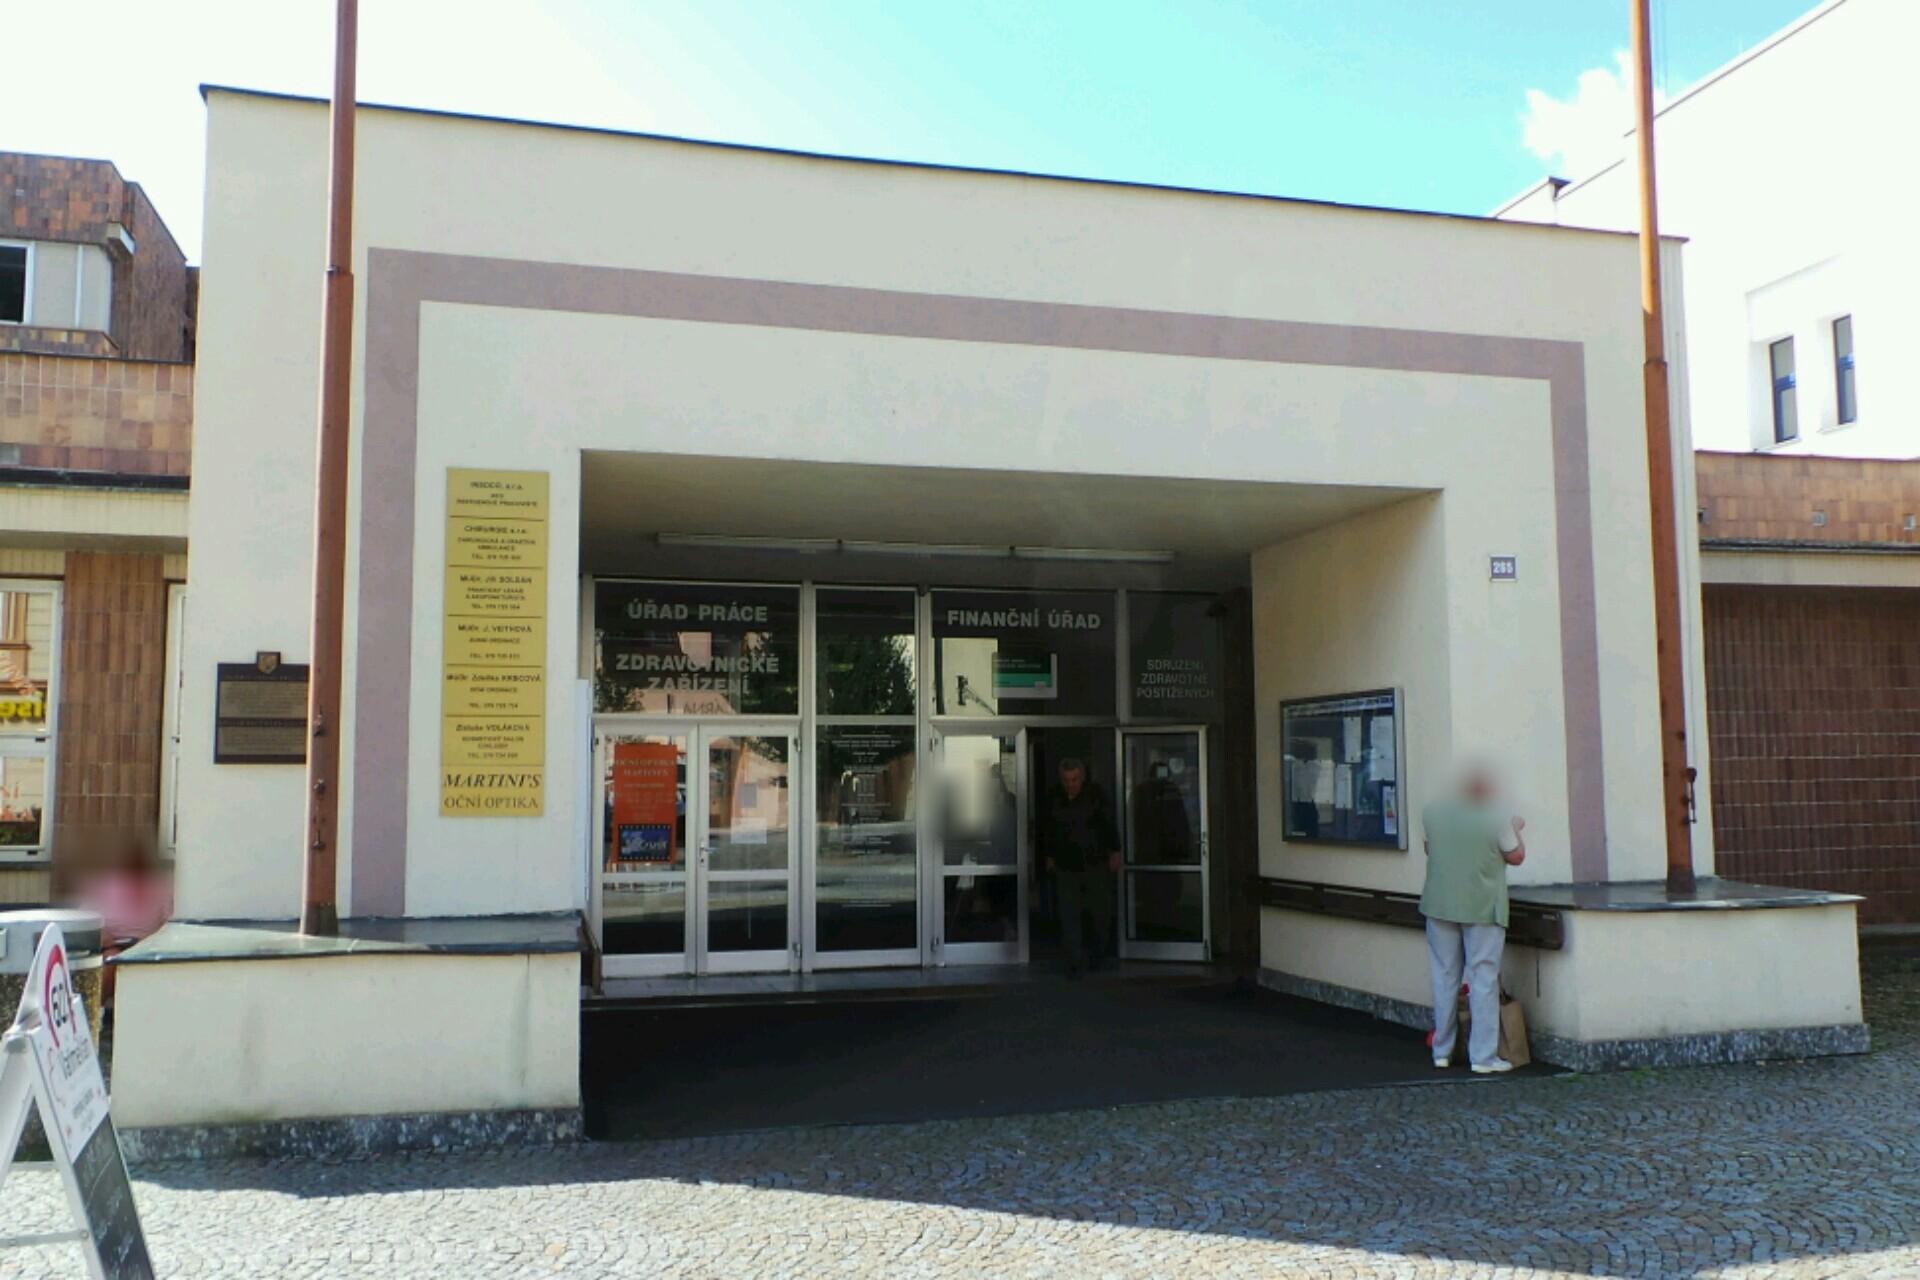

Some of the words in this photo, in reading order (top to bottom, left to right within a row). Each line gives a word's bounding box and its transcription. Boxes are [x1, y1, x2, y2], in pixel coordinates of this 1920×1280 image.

[628, 599, 688, 620] ÚŘAD
[699, 602, 768, 622] PRÁCE
[947, 608, 1040, 628] FINANČNÍ
[1048, 609, 1101, 629] ÚŘAD
[615, 650, 779, 673] ZDRAVOTNICKÉ
[648, 673, 750, 695] ZAŘÍZENÍ
[443, 794, 481, 809] OČNÍ
[484, 797, 538, 809] OPTIKA
